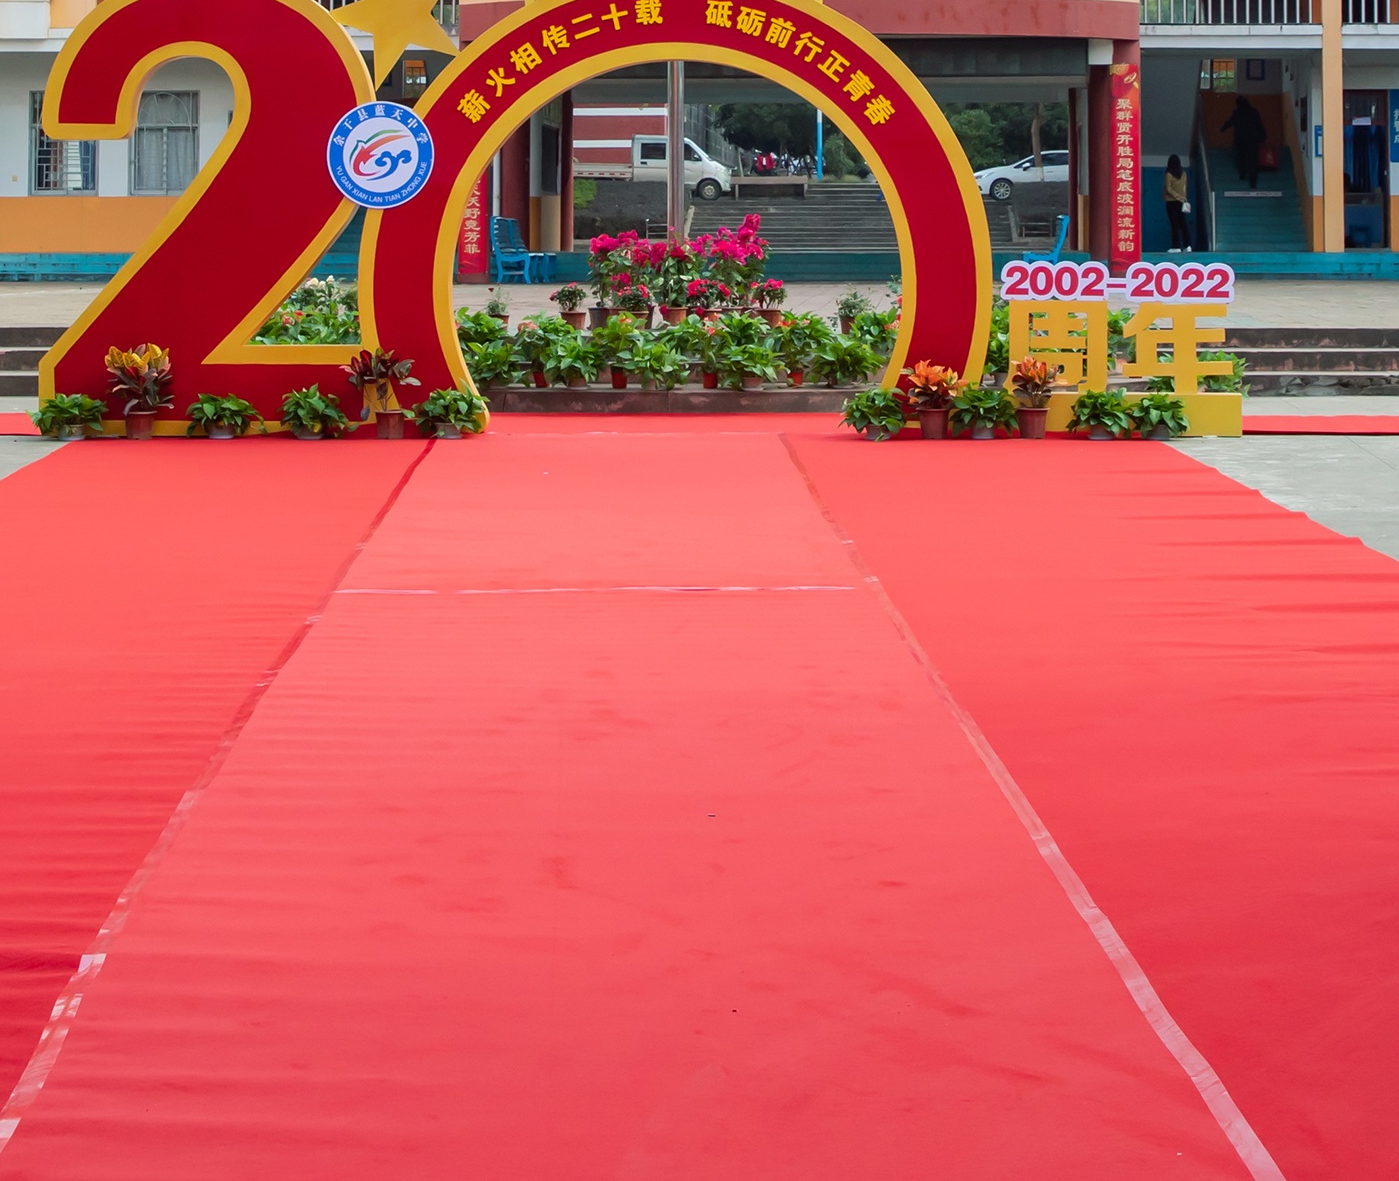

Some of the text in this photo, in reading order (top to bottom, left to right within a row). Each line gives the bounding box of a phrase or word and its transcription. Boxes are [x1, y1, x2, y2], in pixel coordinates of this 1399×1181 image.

[332, 104, 429, 148] 余干县蓝天中学
[336, 161, 428, 203] YU GAN XIAN LAN TIAN ZHONG XUE
